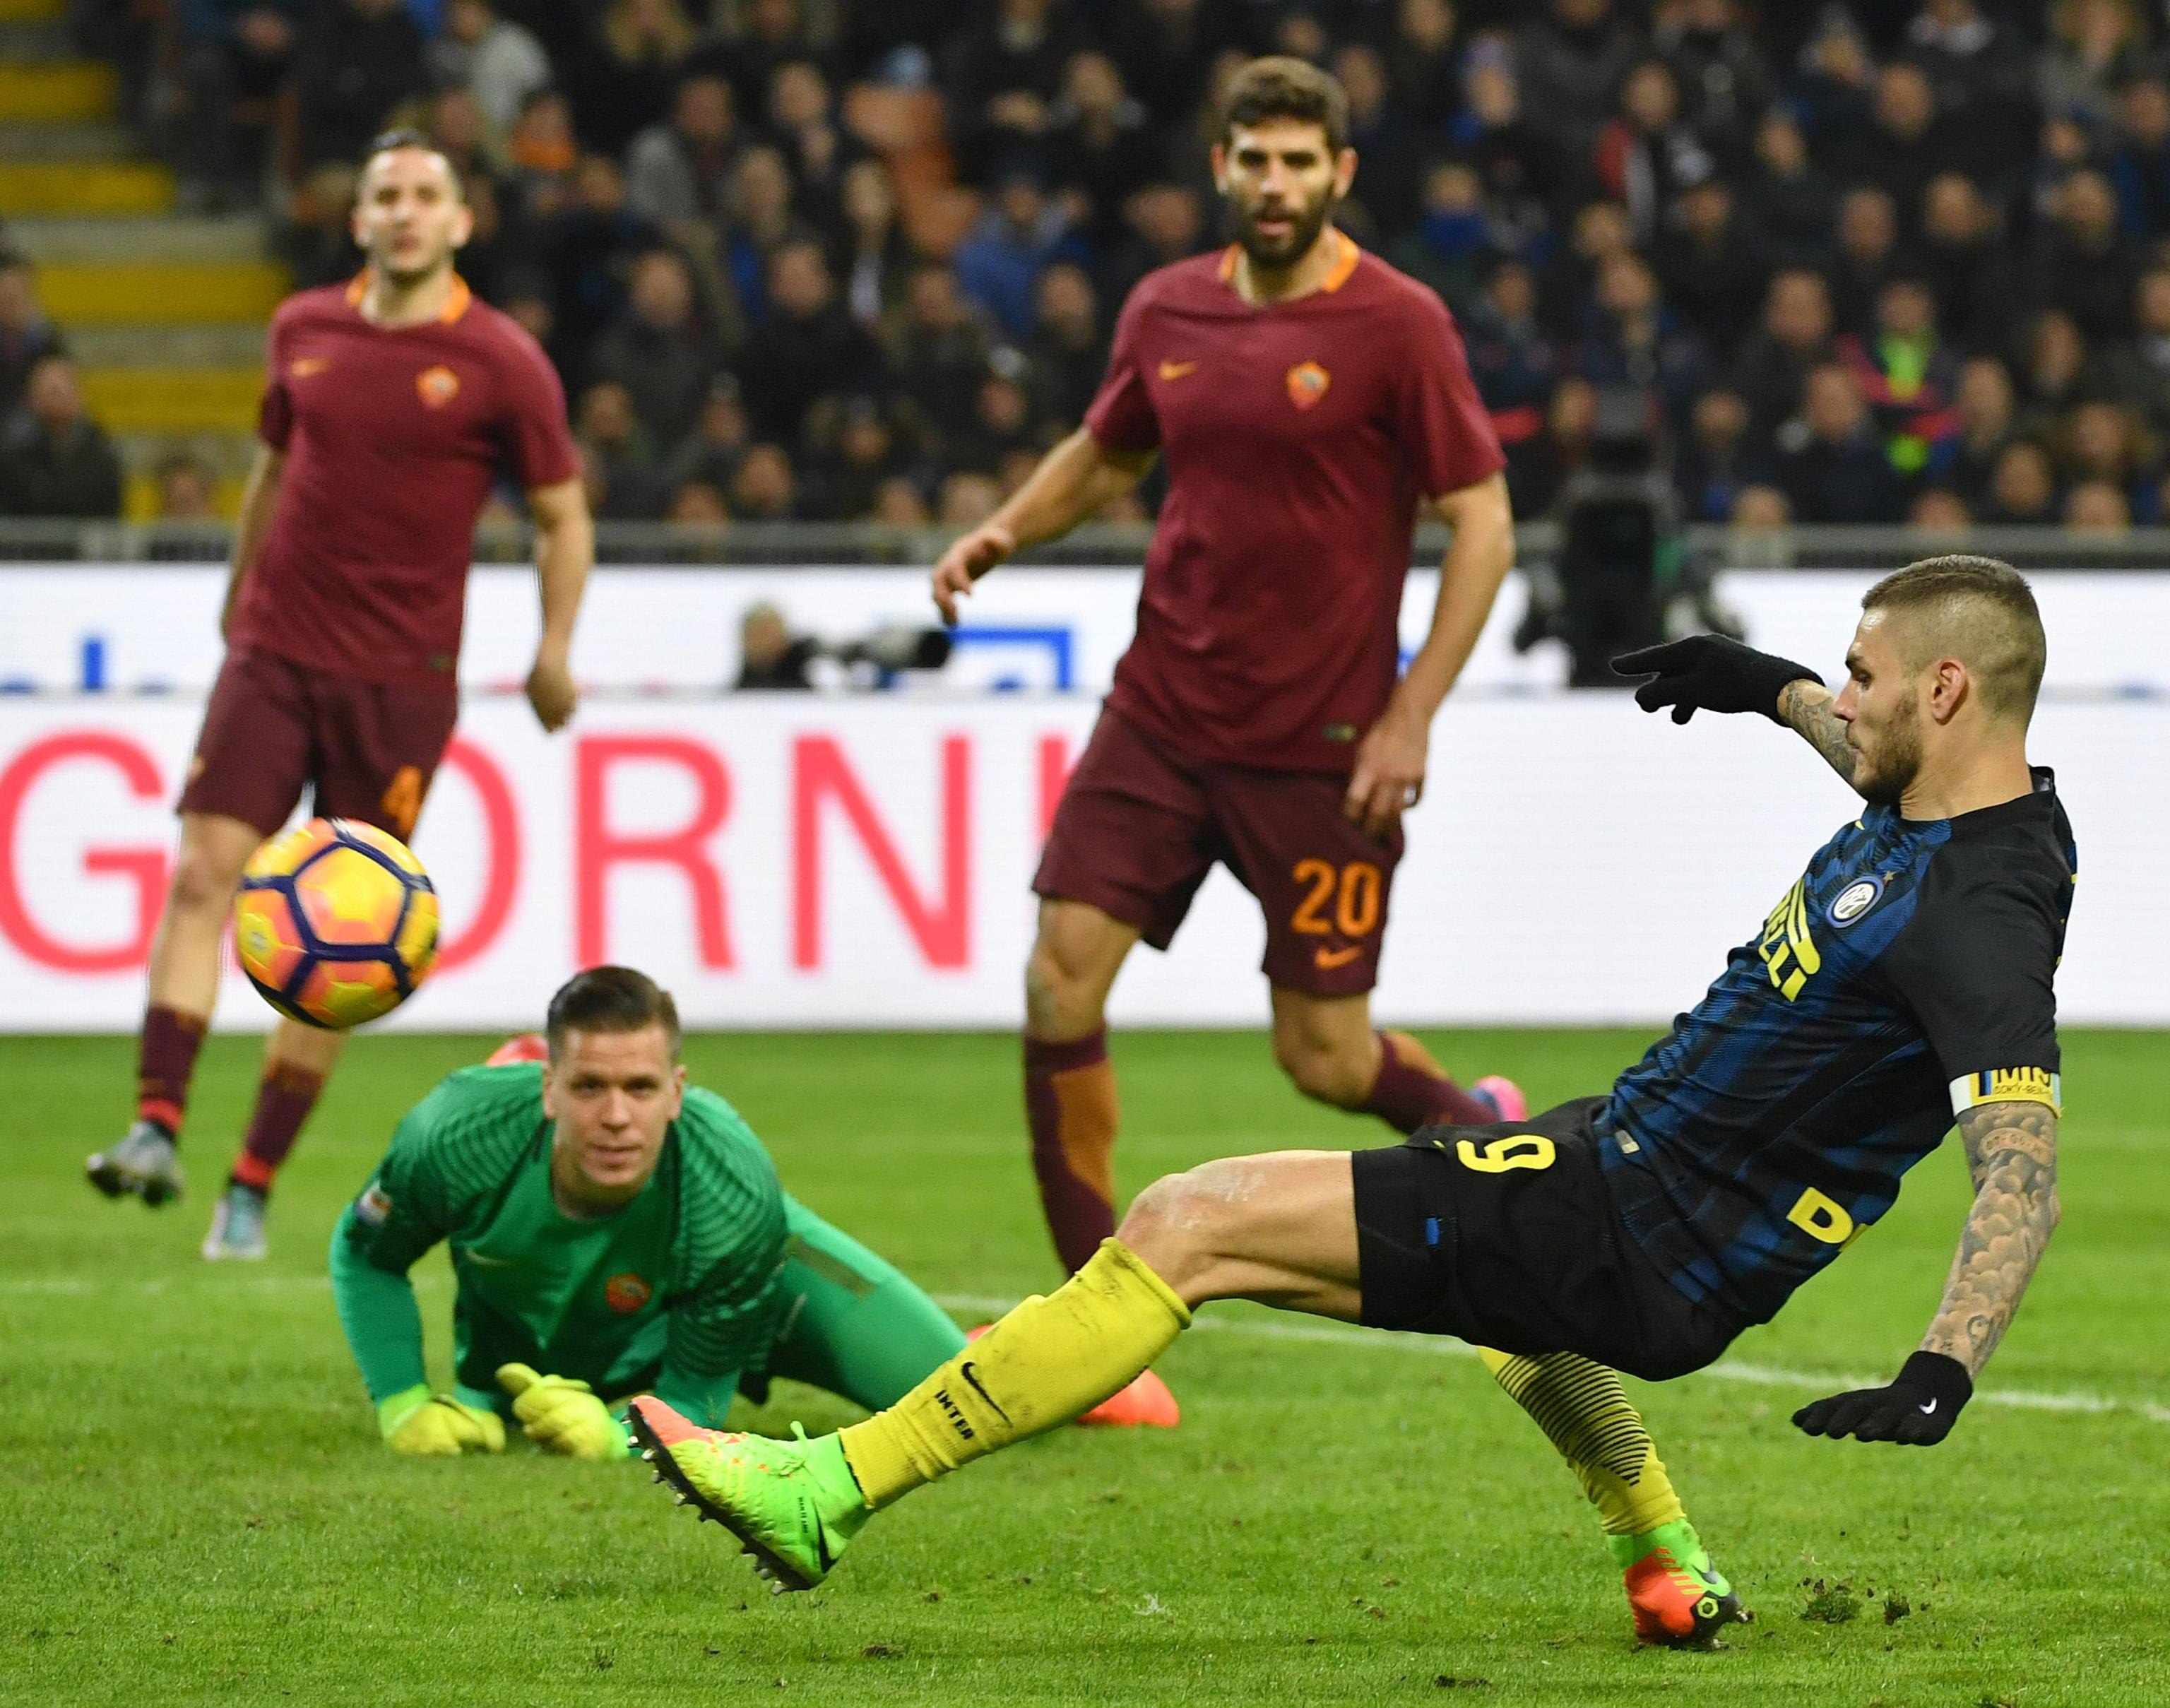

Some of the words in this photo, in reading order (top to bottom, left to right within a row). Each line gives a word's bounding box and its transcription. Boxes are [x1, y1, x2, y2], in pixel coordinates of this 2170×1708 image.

[382, 764, 422, 834] 4
[1291, 859, 1381, 936] 20
[1456, 1134, 1556, 1173] 9
[934, 1389, 975, 1440] INTER
